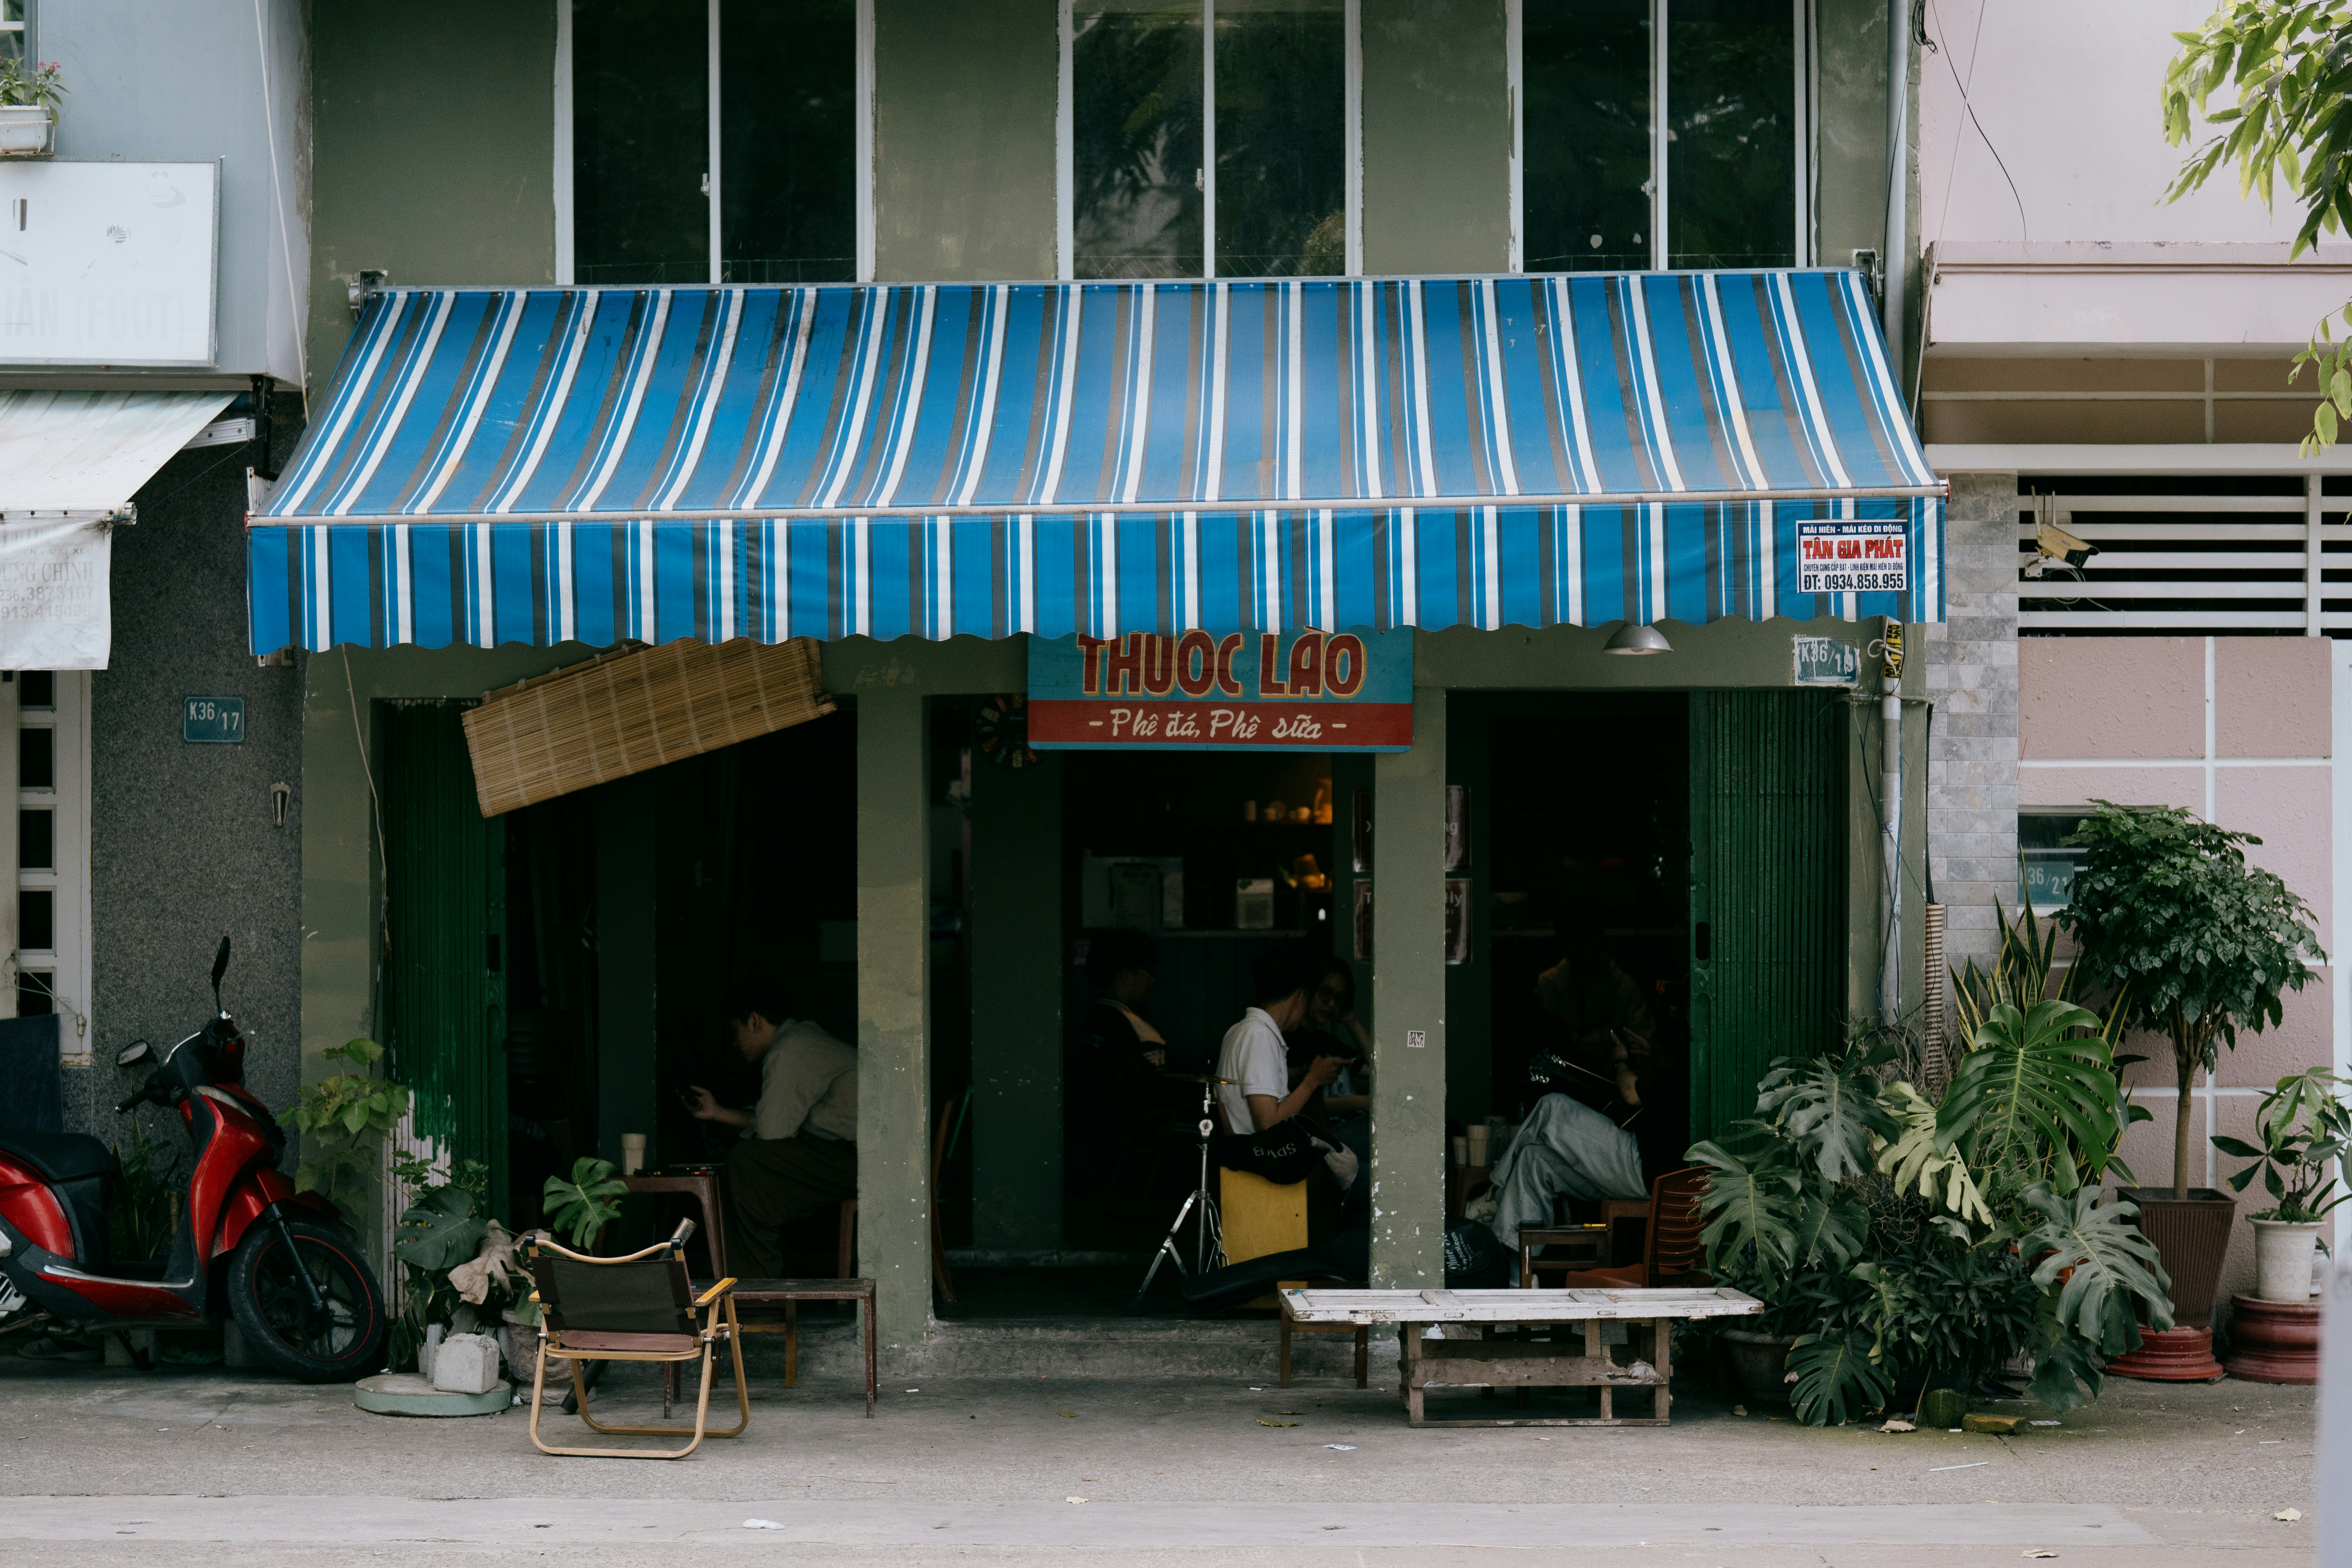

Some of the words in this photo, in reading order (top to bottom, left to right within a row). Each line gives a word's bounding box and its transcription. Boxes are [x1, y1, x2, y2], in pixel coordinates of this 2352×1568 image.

[1803, 525, 1817, 534] MÁI
[1819, 525, 1835, 533] HIÊN
[1842, 525, 1856, 533] MÁI
[1858, 524, 1872, 533] KÉO
[1883, 524, 1903, 534] ĐỘNG
[1803, 536, 1833, 559] TÂN
[1837, 540, 1862, 559] GIA
[1865, 536, 1903, 558] PHÁT
[1860, 561, 1868, 572] KIỆN
[1804, 574, 1821, 590] ĐT:
[1825, 574, 1903, 590] 0934.858.955
[190, 702, 240, 730] K36/17
[1110, 708, 1159, 737] Phê
[1165, 711, 1200, 738] đá,
[1210, 709, 1261, 738] Phê
[1272, 714, 1322, 738] sữa
